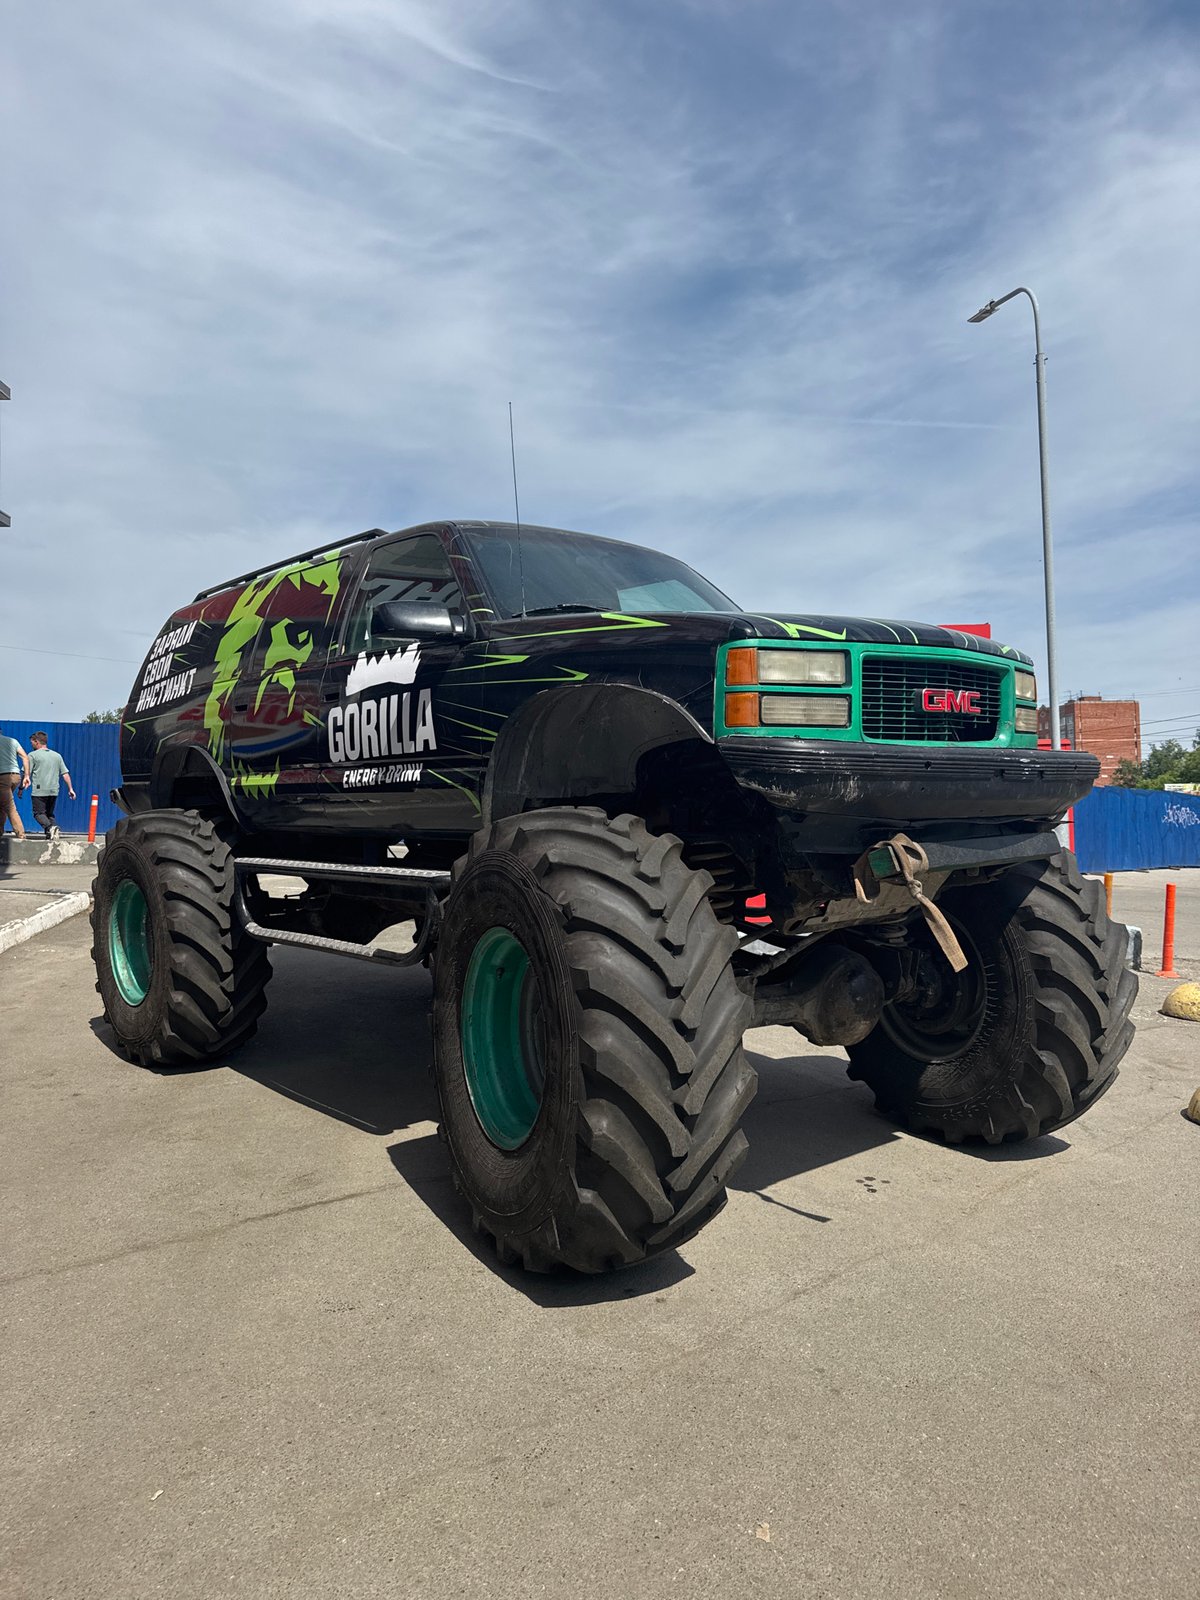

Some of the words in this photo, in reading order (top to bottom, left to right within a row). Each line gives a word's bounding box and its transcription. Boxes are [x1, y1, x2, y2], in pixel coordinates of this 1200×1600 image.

[150, 620, 198, 660] ЗАРЯДИ
[135, 667, 197, 713] ИНСТИНКТ
[922, 688, 981, 713] GMC
[328, 688, 437, 763] GORILLA
[343, 767, 387, 788] ENERGY
[385, 763, 423, 784] DRINK
